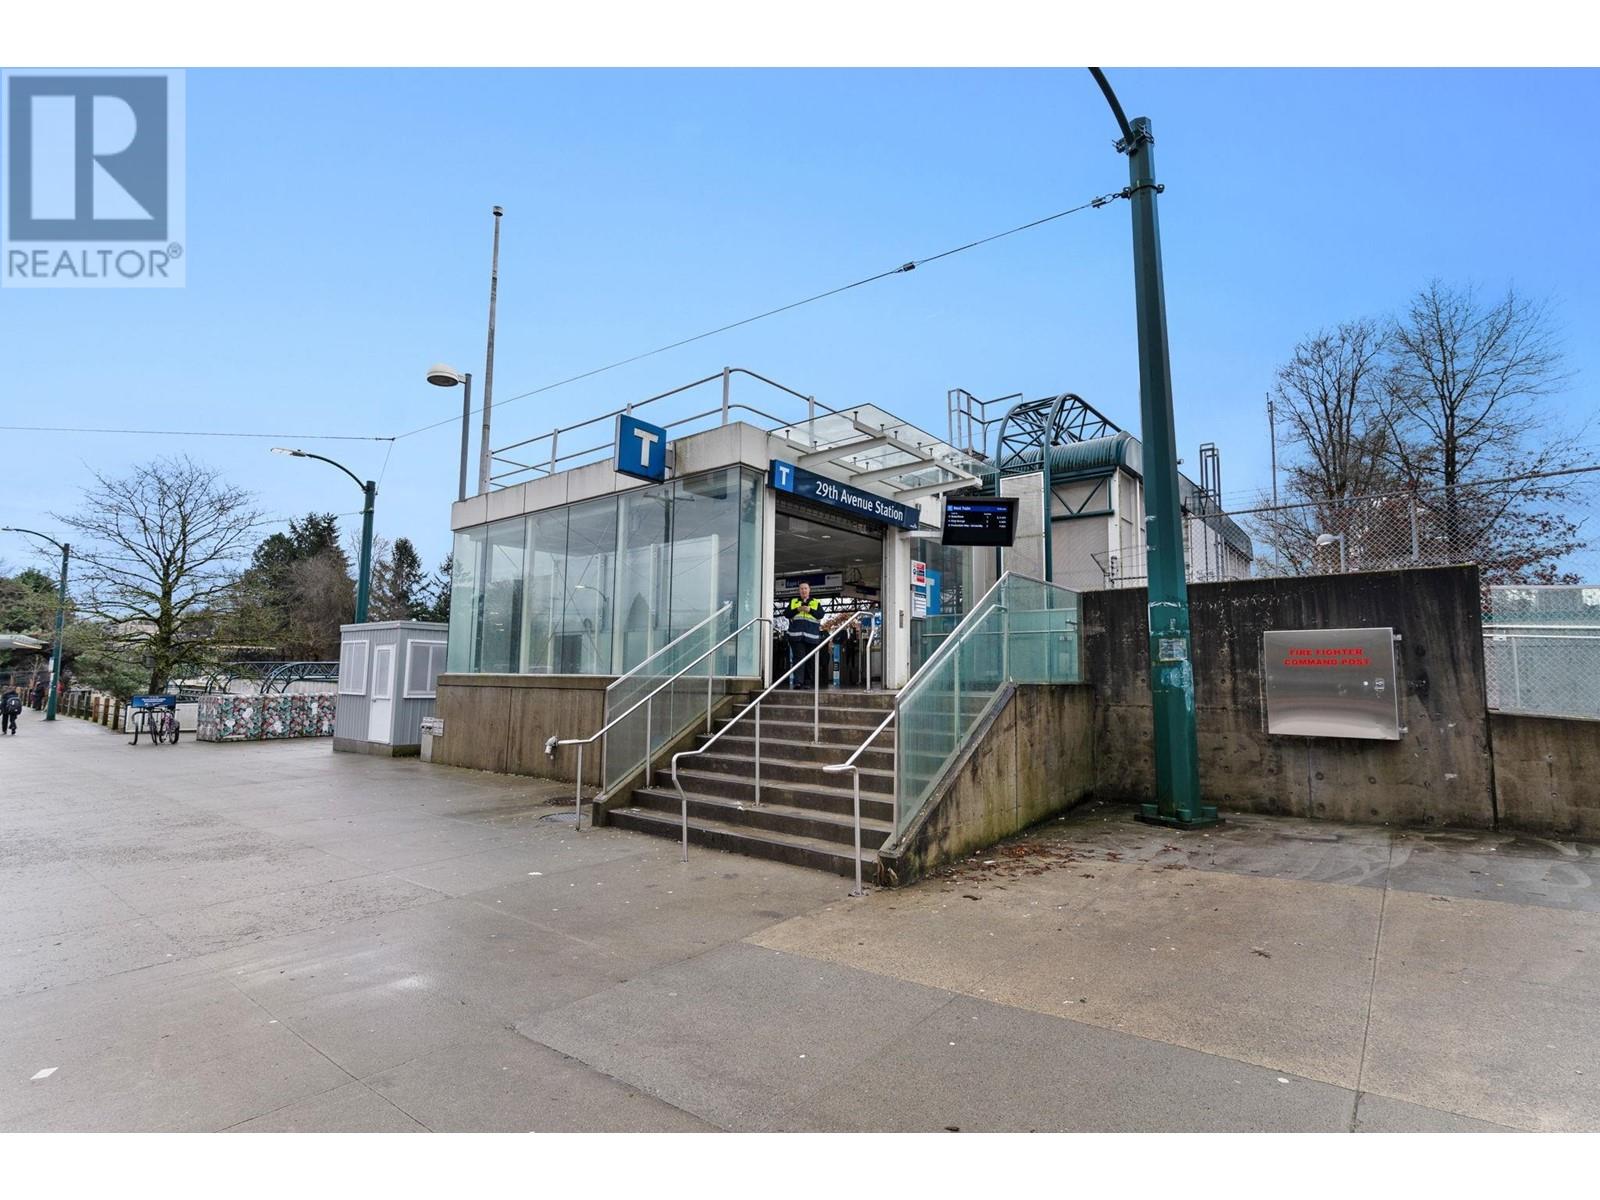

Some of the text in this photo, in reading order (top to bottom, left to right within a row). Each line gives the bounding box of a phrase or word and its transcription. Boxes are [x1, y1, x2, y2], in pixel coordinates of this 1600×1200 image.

[633, 427, 659, 467] T
[779, 465, 790, 486] T
[815, 480, 904, 522] 29th Avenue Station
[1284, 658, 1370, 666] COMMAND POST
[1289, 648, 1363, 656] FIRE FIGHTER
